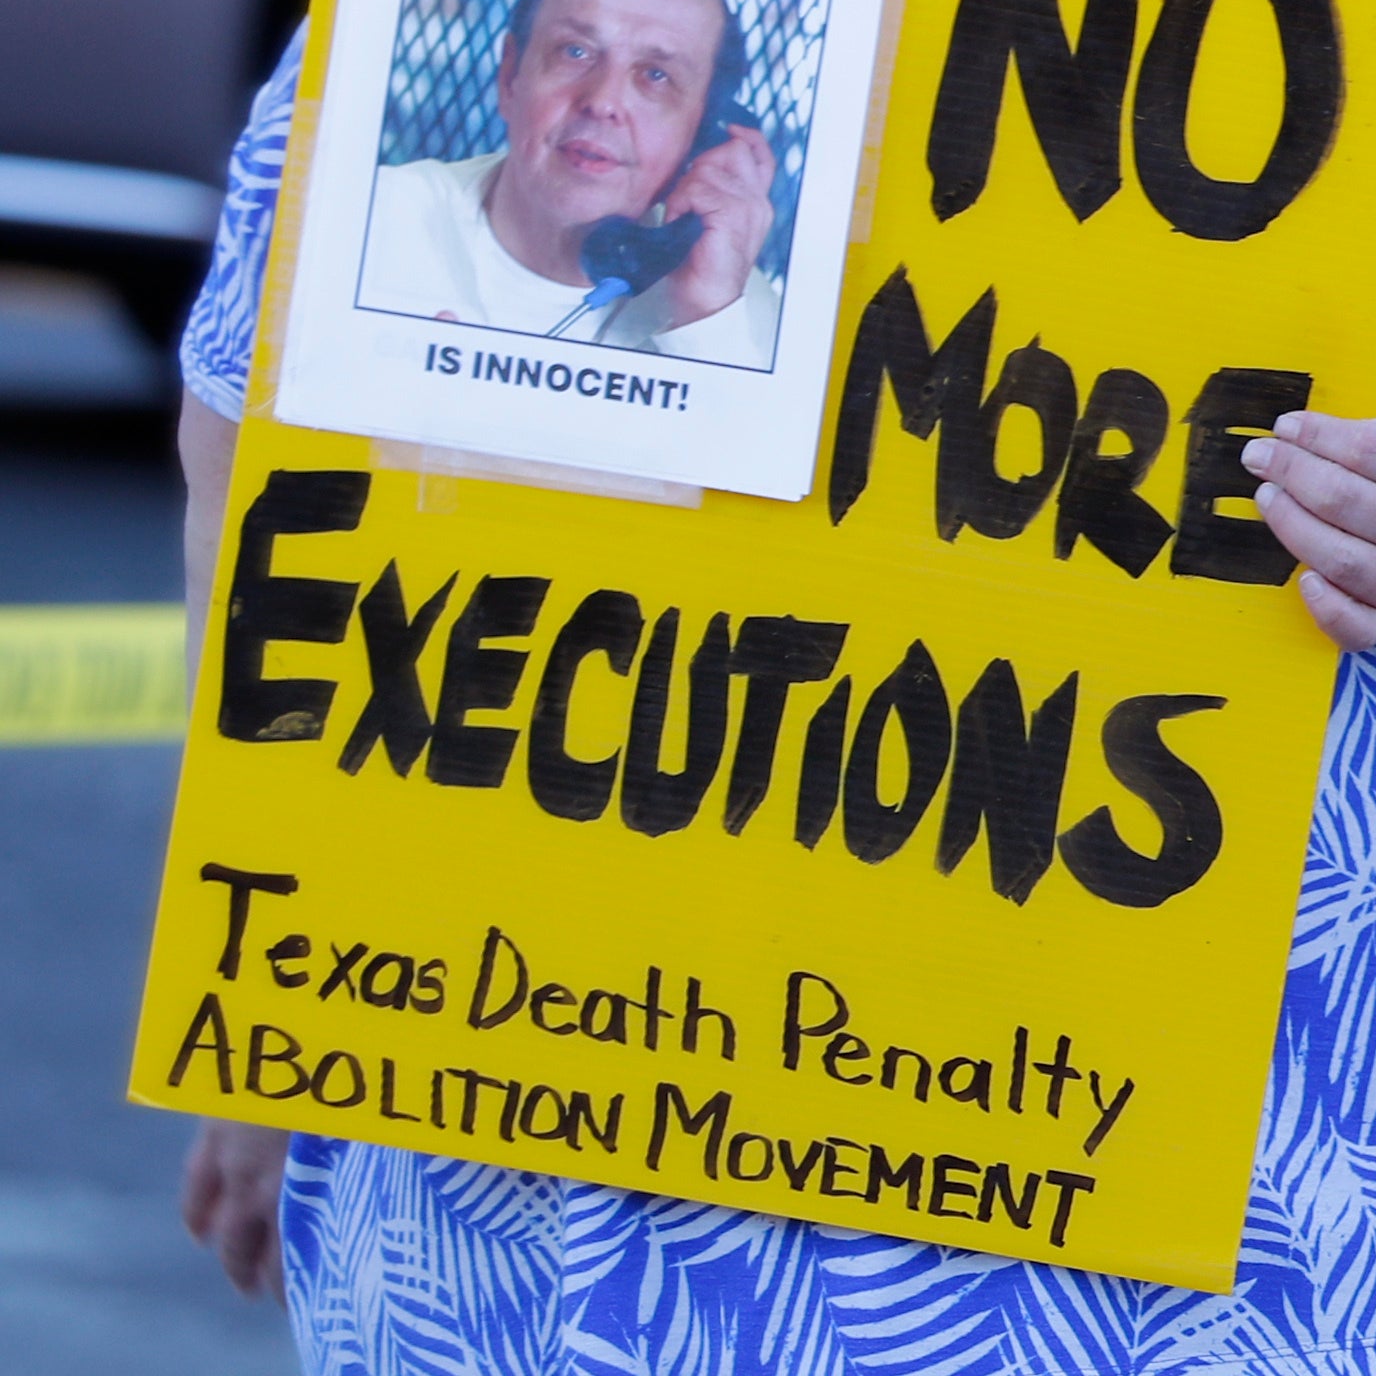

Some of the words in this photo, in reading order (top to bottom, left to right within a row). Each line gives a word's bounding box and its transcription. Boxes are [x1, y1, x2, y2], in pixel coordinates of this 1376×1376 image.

[425, 343, 462, 375] IS
[471, 350, 690, 411] INNOCENT!
[828, 261, 1314, 587] MORE
[217, 469, 1228, 910] EXECUTIONS
[166, 992, 625, 1154] ABOLITION
[644, 1082, 1096, 1249] MOVEMENT
[200, 862, 449, 1015] Texas
[466, 925, 737, 1062] Death
[782, 971, 1136, 1158] Penalty
